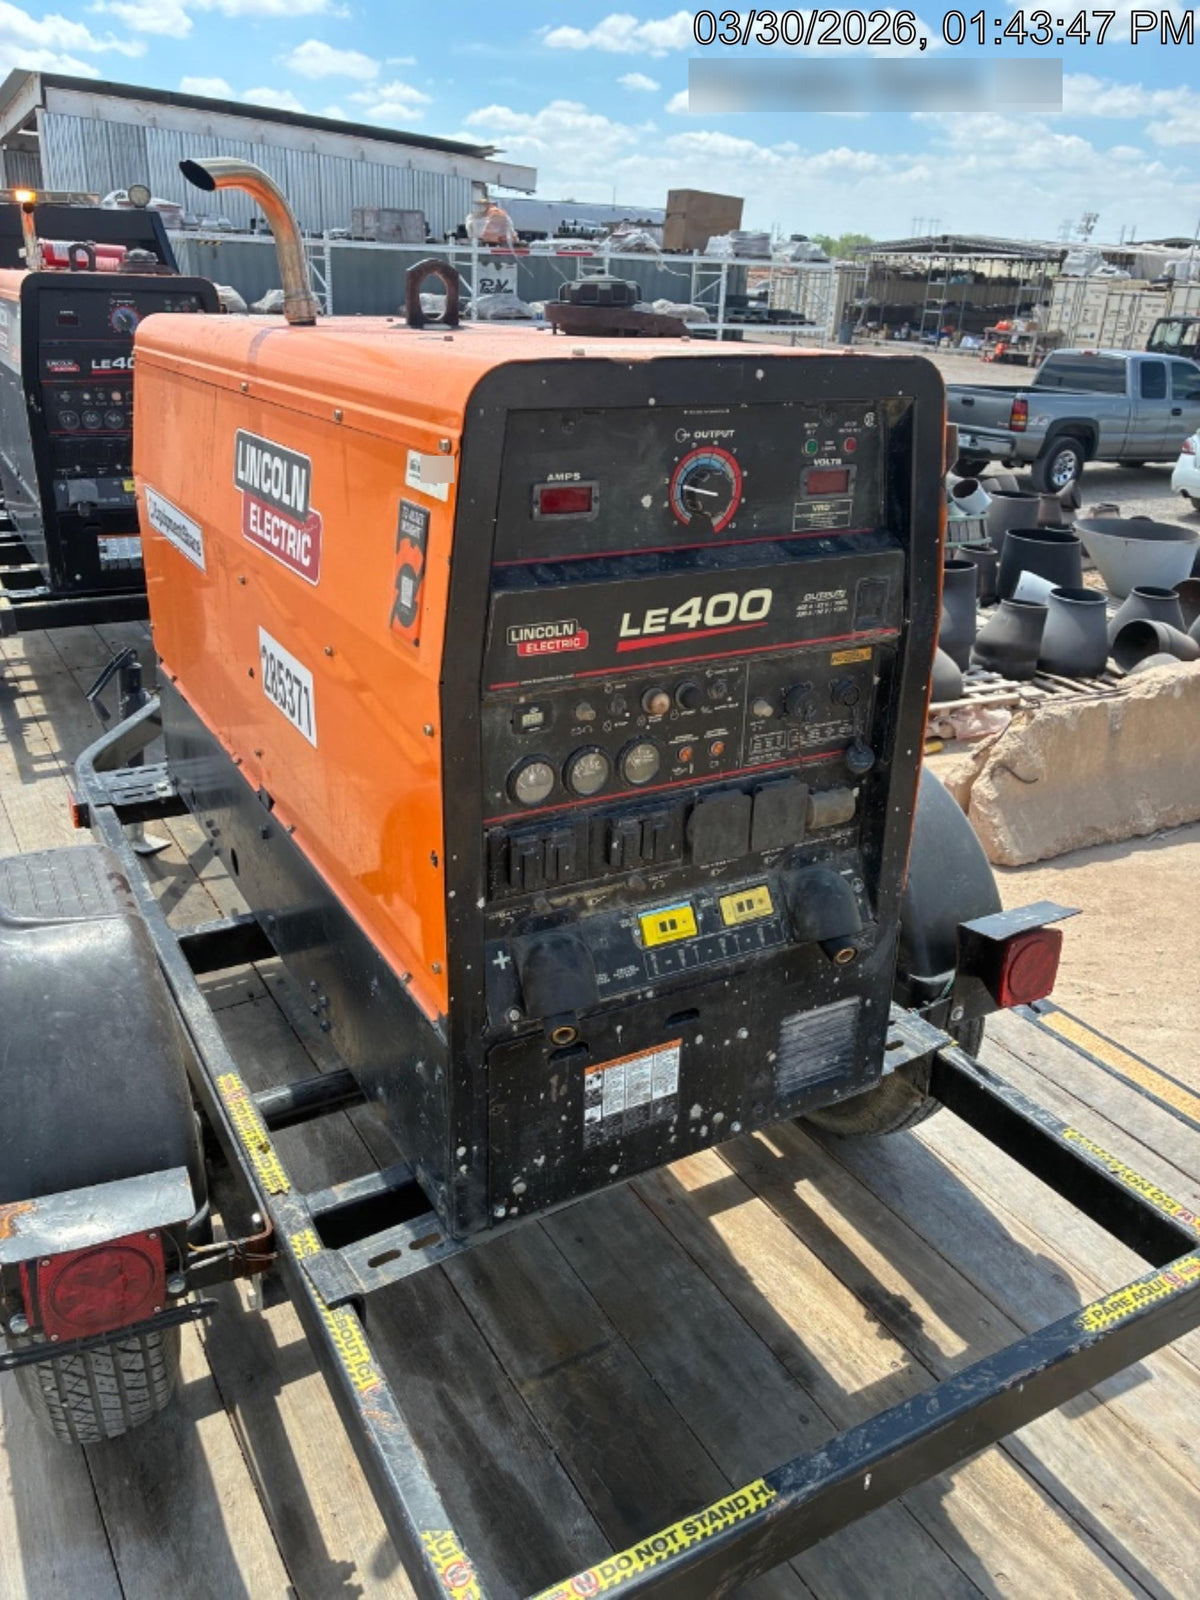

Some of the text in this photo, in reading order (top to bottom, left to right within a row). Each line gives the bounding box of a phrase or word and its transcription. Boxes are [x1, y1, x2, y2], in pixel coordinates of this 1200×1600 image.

[694, 429, 736, 439] OUTPUT
[237, 441, 307, 513] LINCOLN
[547, 471, 581, 482] AMPS
[249, 501, 312, 568] ELECTRIC
[511, 623, 574, 642] LINCOLN
[619, 588, 773, 638] LE400
[525, 637, 581, 653] ELECTRIC
[261, 644, 312, 738] 285371
[1092, 1295, 1133, 1320] PARE
[331, 1309, 376, 1384] EBOUT ICI
[599, 1482, 774, 1581] DO NOT STAND H
